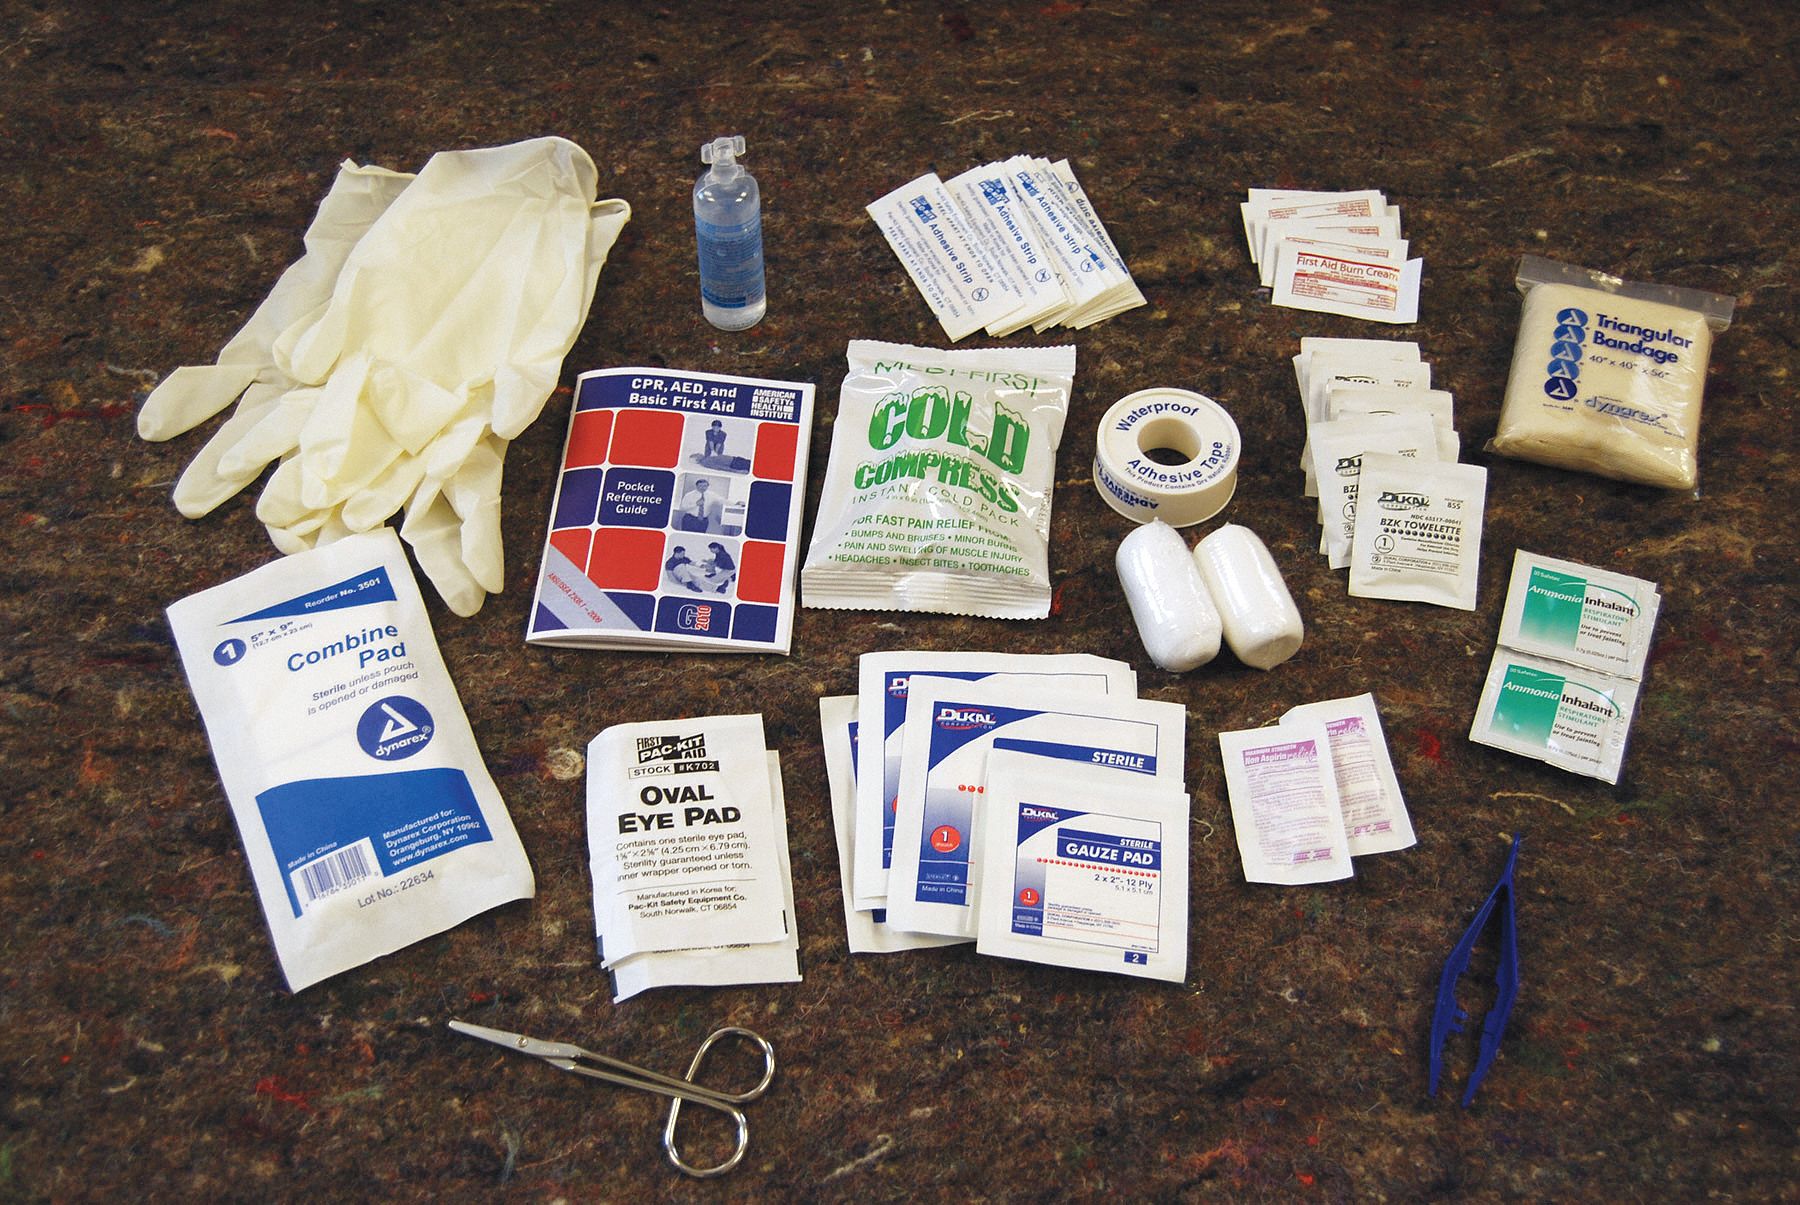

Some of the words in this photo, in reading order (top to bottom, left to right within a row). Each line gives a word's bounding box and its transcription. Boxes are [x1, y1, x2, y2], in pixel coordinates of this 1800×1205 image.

[994, 203, 1024, 243] Adhesive
[1017, 241, 1039, 266] Strip
[1036, 194, 1066, 233] Adhesive
[1062, 232, 1082, 255] Strip
[928, 220, 960, 263] Adhesive
[953, 261, 974, 285] Strip
[1297, 256, 1318, 266] First
[1320, 260, 1338, 270] Aid
[1340, 264, 1363, 275] Burn
[1366, 267, 1398, 281] Cream
[1597, 313, 1693, 349] Triangular
[1593, 330, 1678, 364] Bandage
[631, 378, 668, 393] CPR,
[670, 381, 708, 397] AED,
[710, 387, 737, 398] and
[753, 389, 796, 399] AMERICAN
[629, 393, 667, 405] Basic
[672, 396, 706, 410] First
[710, 400, 735, 413] Aid
[752, 402, 784, 412] HEALTH
[751, 410, 793, 420] INSTITUTE
[1115, 402, 1200, 433] Waterproof
[868, 385, 1030, 475] COLD
[1128, 458, 1203, 484] Adhesive
[1200, 441, 1223, 470] Tape
[617, 480, 655, 493] Pocket
[854, 448, 1021, 513] COMPRESS
[606, 491, 663, 505] Reference
[928, 486, 972, 507] COLD
[981, 503, 1020, 528] PACK
[1377, 492, 1430, 507] DUKAL
[615, 503, 648, 515] Guide
[875, 514, 904, 527] FAST
[907, 517, 933, 529] PAIN
[936, 518, 975, 530] RELIEF
[1380, 518, 1402, 528] BZK
[1404, 521, 1461, 536] TOWELETTE
[851, 530, 883, 539] BUMPS
[885, 531, 905, 540] AND
[907, 533, 945, 542] BRUISES
[954, 535, 985, 545] MINOR
[844, 542, 865, 550] PAIN
[867, 543, 886, 551] AND
[935, 546, 948, 554] OF
[950, 547, 988, 558] MUSCLE
[990, 551, 1023, 563] INJURY
[834, 553, 891, 565] HEADACHES
[899, 558, 931, 567] INSECT
[933, 560, 959, 569] BITES
[968, 562, 1030, 577] TOOTHACHES
[304, 592, 339, 609] Reorder
[339, 585, 356, 597] No.
[357, 576, 381, 591] 3501
[1528, 585, 1582, 603] Ammonia
[1585, 597, 1635, 617] Inhalant
[695, 604, 712, 631] 2010
[222, 643, 237, 660] 1
[288, 624, 399, 672] Combine
[359, 642, 407, 669] Pad
[310, 682, 346, 701] Sterile
[347, 669, 381, 686] unless
[382, 658, 415, 677] pouch
[307, 707, 317, 716] is
[316, 690, 357, 712] opened
[358, 686, 369, 695] or
[370, 668, 418, 692] damaged
[1503, 681, 1560, 701] Ammonia
[1561, 694, 1613, 717] Inhalant
[937, 708, 996, 724] DUKAL
[376, 733, 428, 756] dynarex
[637, 736, 661, 750] FIRST
[684, 748, 706, 759] AID
[1091, 751, 1145, 768] STERILE
[634, 765, 671, 776] STOCK
[679, 763, 715, 772] #K702
[640, 785, 714, 806] OVAL
[381, 813, 440, 840] Manufactured
[439, 807, 455, 818] for:
[618, 812, 674, 834] EYE
[684, 807, 741, 826] PAD
[1022, 807, 1059, 820] DUKAL
[384, 829, 421, 849] Dynarex
[421, 811, 471, 835] Corporation
[387, 832, 443, 858] Orangeburg,
[441, 826, 455, 836] NY
[456, 819, 480, 833] 10962
[942, 831, 948, 842] 1
[391, 832, 469, 866] www.dynarex.com
[616, 837, 656, 851] Contains
[658, 838, 676, 846] one
[678, 834, 705, 843] sterile
[708, 833, 725, 842] eye
[727, 832, 747, 842] pad,
[661, 846, 684, 856] (4.25
[709, 842, 730, 851] 6.79
[1120, 838, 1153, 849] STERILE
[624, 859, 657, 870] Sterility
[660, 854, 712, 866] guaranteed
[714, 852, 744, 860] unless
[1066, 843, 1118, 861] GAUZE
[1123, 853, 1153, 865] PAD
[617, 872, 638, 882] inner
[641, 868, 679, 878] wrapper
[682, 864, 717, 874] opened
[358, 894, 374, 909] Lot
[376, 886, 400, 900] No.:
[400, 869, 434, 891] 22634
[921, 884, 939, 892] Made
[946, 886, 964, 895] China
[1126, 879, 1136, 887] 12
[1138, 880, 1153, 890] Ply
[628, 901, 658, 911] Pac-Kit
[660, 898, 686, 907] Safety
[688, 895, 731, 904] Equipment
[637, 889, 689, 901] Manufactured
[640, 910, 663, 919] South
[665, 906, 698, 915] Norwalk,
[1132, 954, 1139, 963] 2
